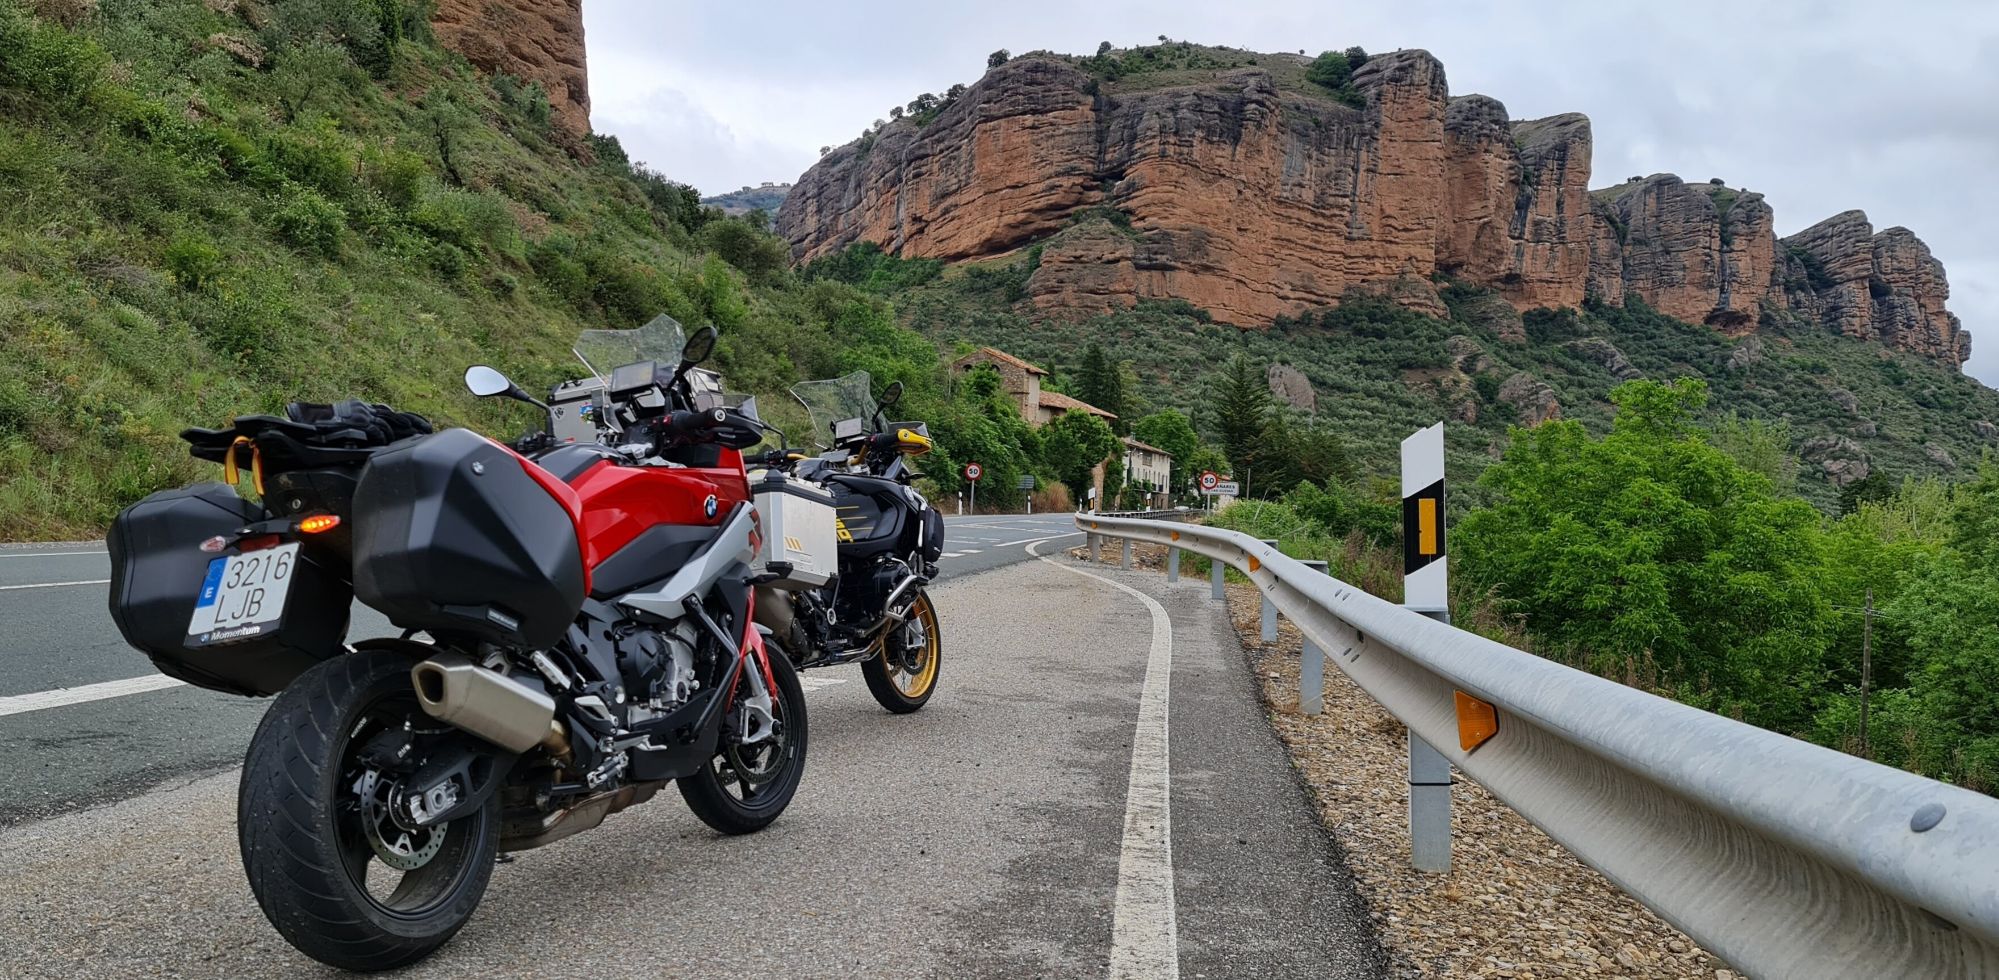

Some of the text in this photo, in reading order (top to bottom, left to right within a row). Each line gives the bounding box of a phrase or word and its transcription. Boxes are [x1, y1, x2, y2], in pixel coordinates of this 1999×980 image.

[227, 551, 291, 589] 3216
[205, 587, 214, 598] E
[214, 588, 265, 624] LJB
[211, 626, 260, 640] Momentum
